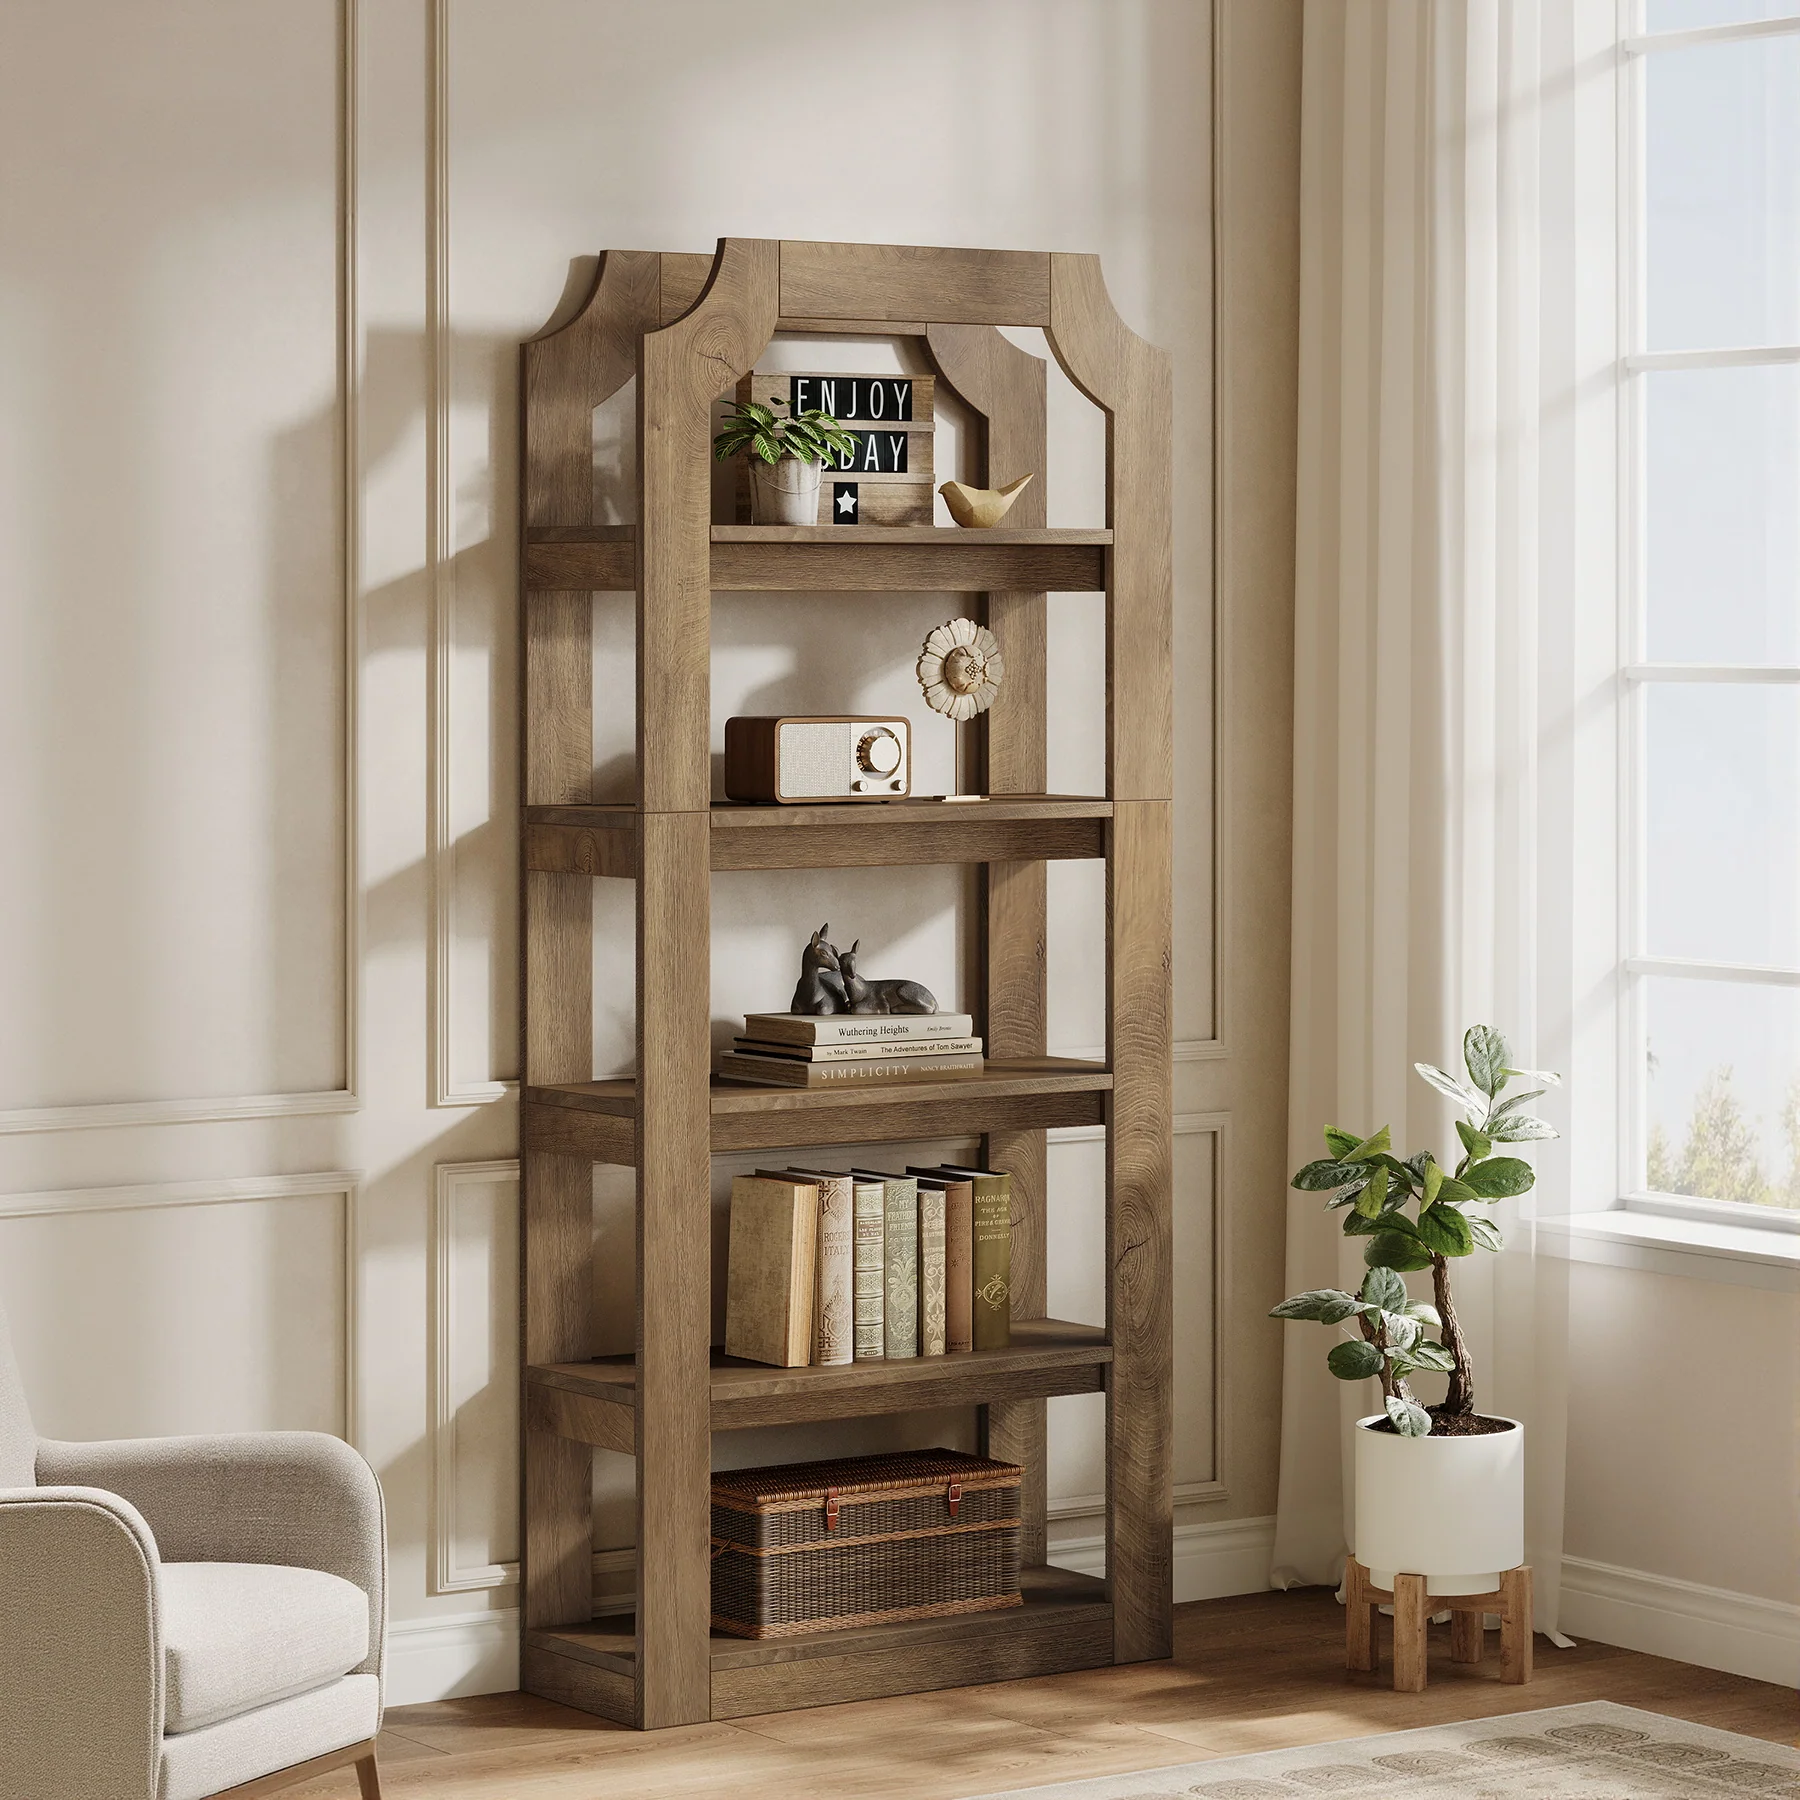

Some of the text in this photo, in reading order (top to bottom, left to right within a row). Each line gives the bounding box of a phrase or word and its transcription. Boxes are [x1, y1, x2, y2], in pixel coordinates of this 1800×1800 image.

[797, 379, 908, 420] ENJOY
[838, 1025, 909, 1037] Wuthering Heights
[893, 1044, 928, 1053] Adventures
[950, 1042, 973, 1050] Sawyer
[821, 1064, 909, 1080] SIMPLICITY
[920, 1064, 939, 1072] NANCY
[979, 1232, 1010, 1241] DONNELLY
